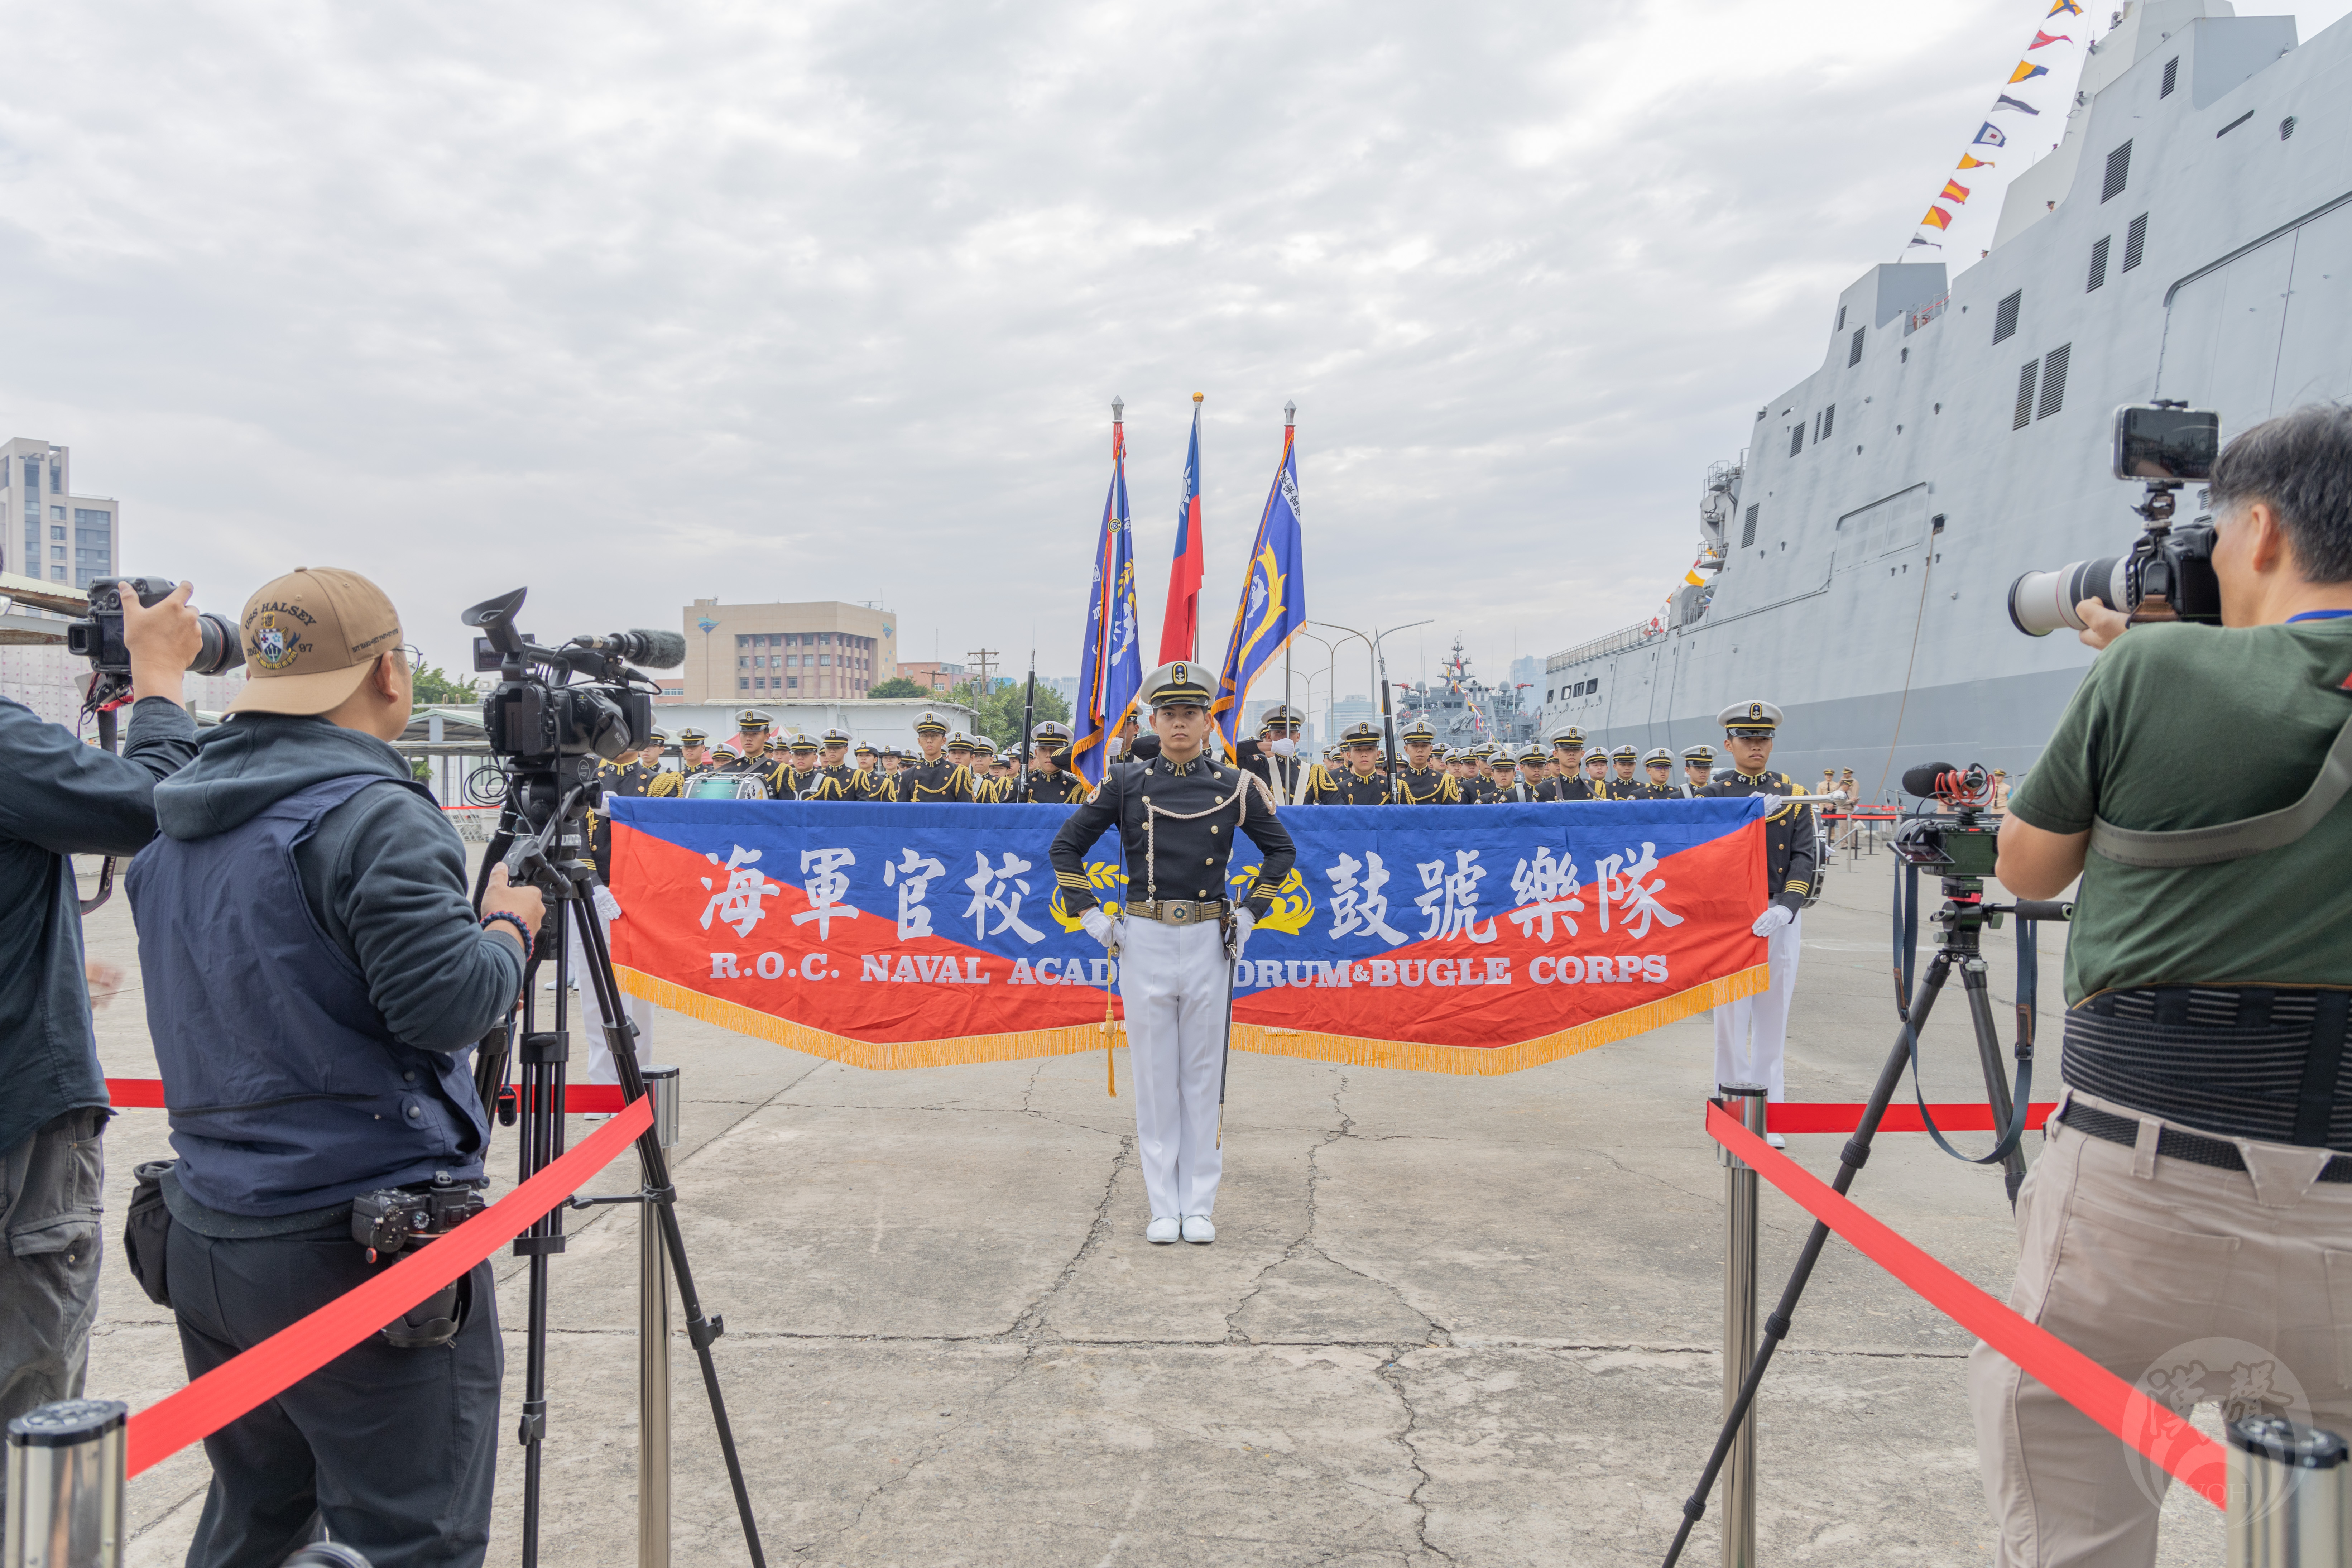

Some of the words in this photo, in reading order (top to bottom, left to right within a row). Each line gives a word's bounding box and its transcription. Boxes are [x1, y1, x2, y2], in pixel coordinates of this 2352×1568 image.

[245, 608, 258, 630] USS
[261, 602, 316, 626] HALSEY
[247, 647, 257, 656] DDG
[299, 643, 313, 652] 97
[614, 732, 626, 747] SONY
[104, 856, 115, 891] Cano
[700, 844, 1046, 944] 海軍官校
[1325, 841, 1684, 946] 鼓號樂隊
[710, 951, 839, 981] R.O.C.
[860, 955, 990, 984] NAVAL
[1007, 957, 1119, 986] ACAD
[1234, 957, 1511, 988] DRUM&BUGLE
[1529, 955, 1669, 984] CORPS
